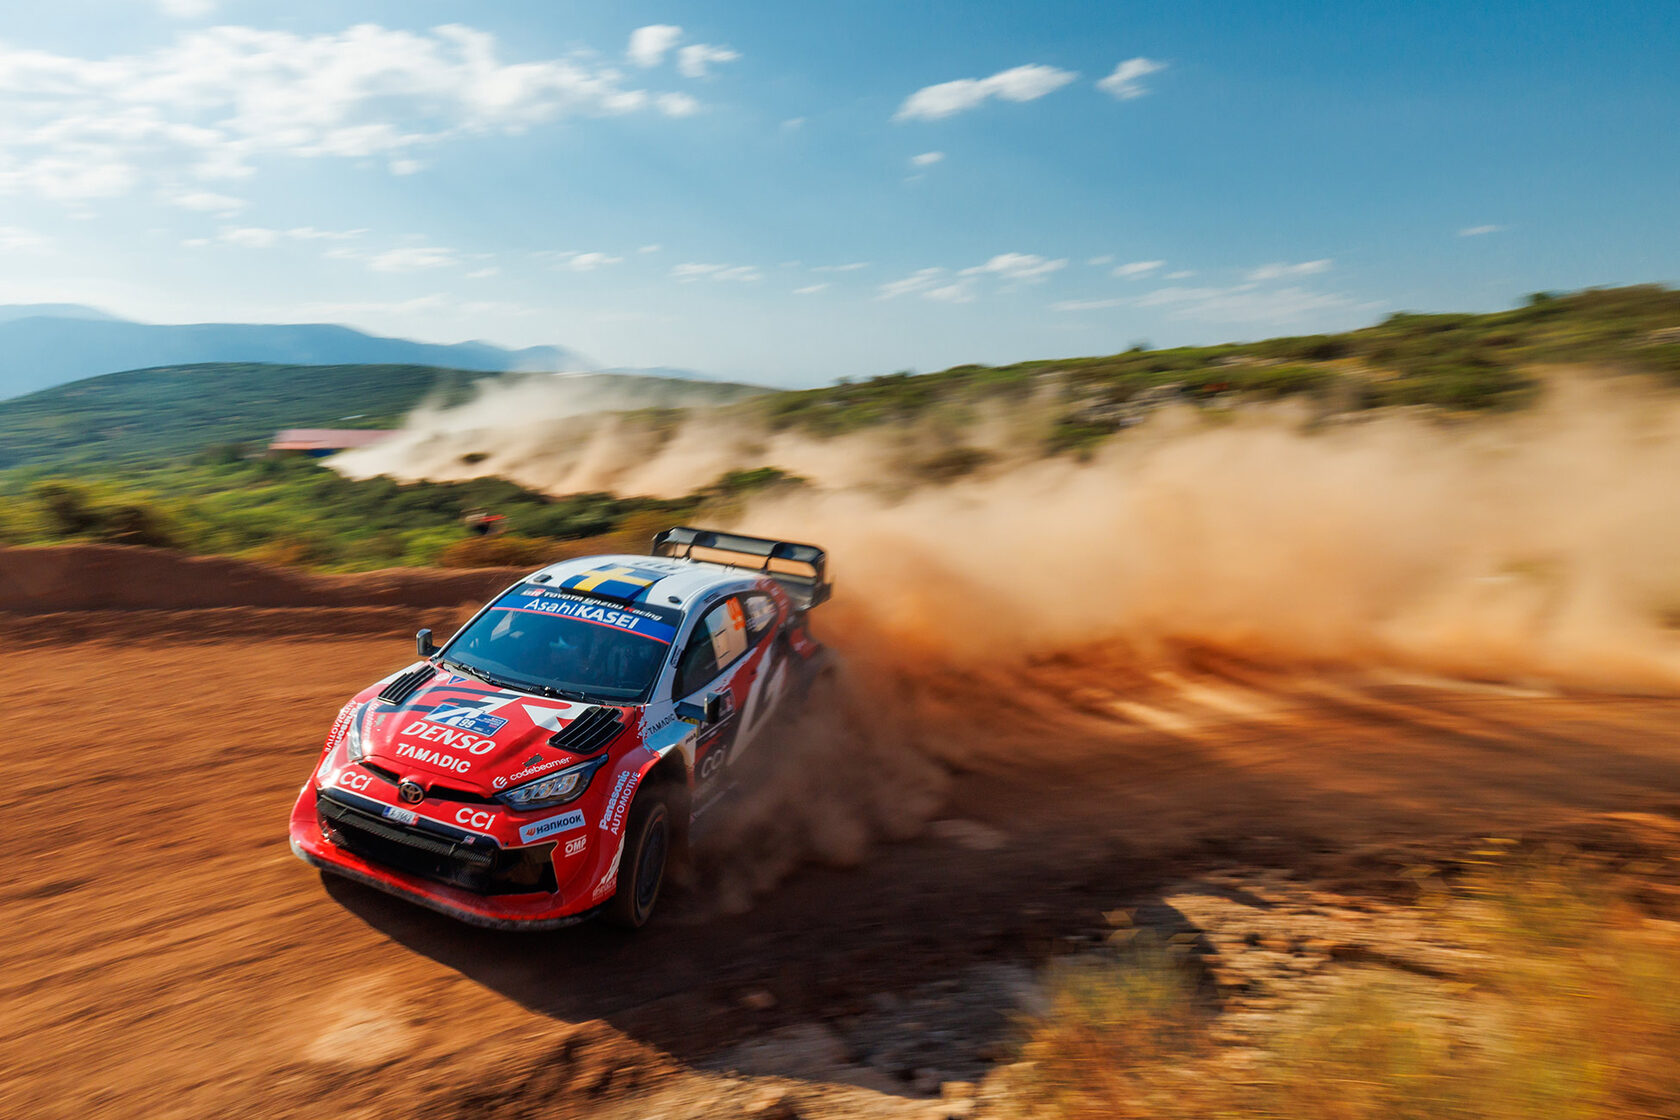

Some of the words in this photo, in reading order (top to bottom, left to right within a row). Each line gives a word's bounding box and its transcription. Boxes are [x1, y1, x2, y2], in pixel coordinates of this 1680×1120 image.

[543, 591, 585, 602] TOYOTA
[458, 718, 477, 728] 99
[401, 721, 497, 756] DENSO
[395, 743, 472, 774] TAMADIC
[509, 756, 570, 782] codebeamer
[599, 770, 630, 831] Panasonic
[610, 771, 641, 836] AUTOMOTIVE
[565, 837, 587, 854] OMP
